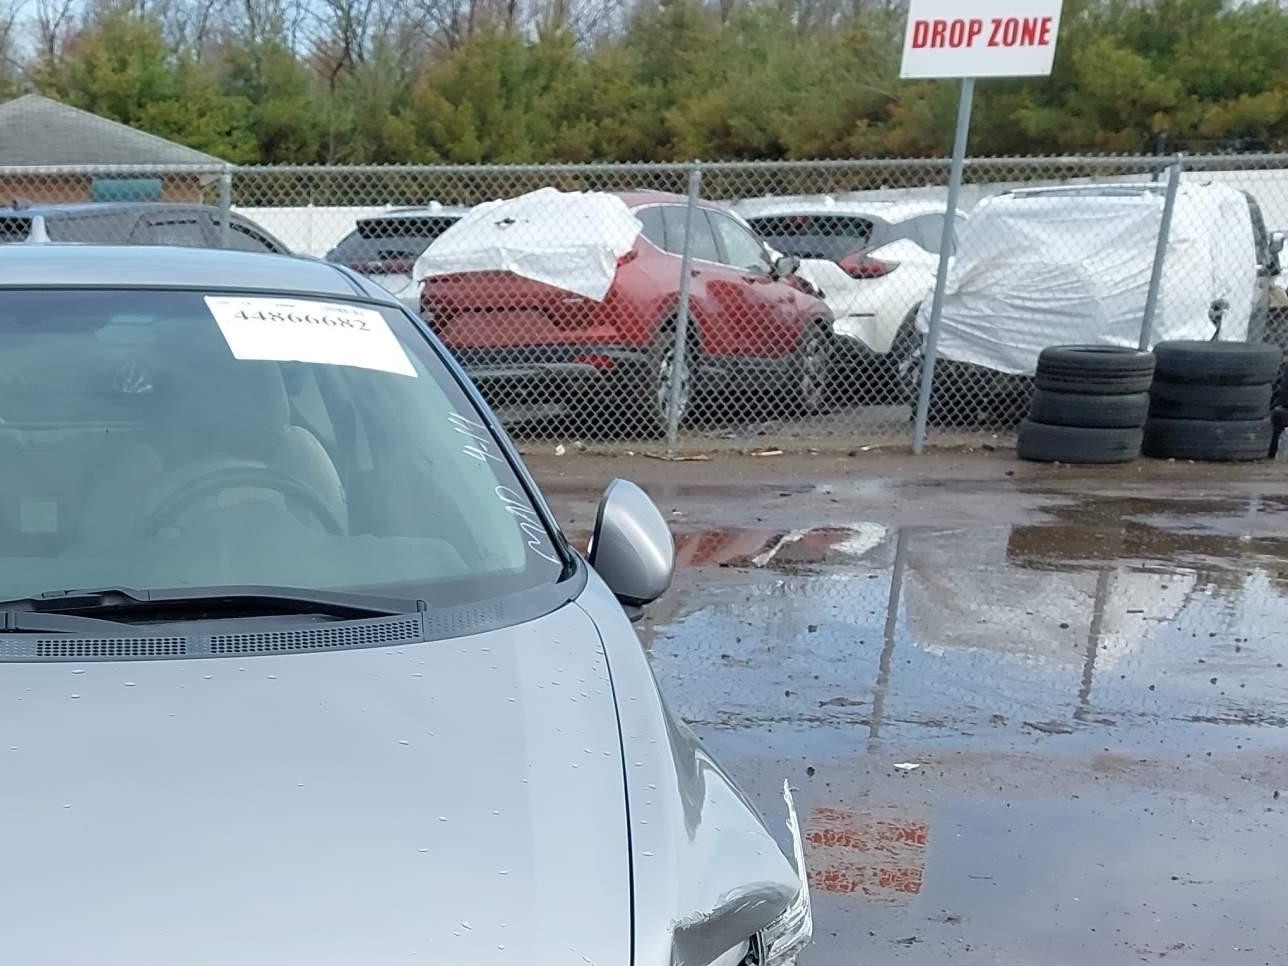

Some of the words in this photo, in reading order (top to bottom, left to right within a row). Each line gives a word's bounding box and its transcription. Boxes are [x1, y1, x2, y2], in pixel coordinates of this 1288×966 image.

[912, 18, 983, 49] DROP
[987, 16, 1053, 48] ZONE
[234, 309, 372, 333] 44866682
